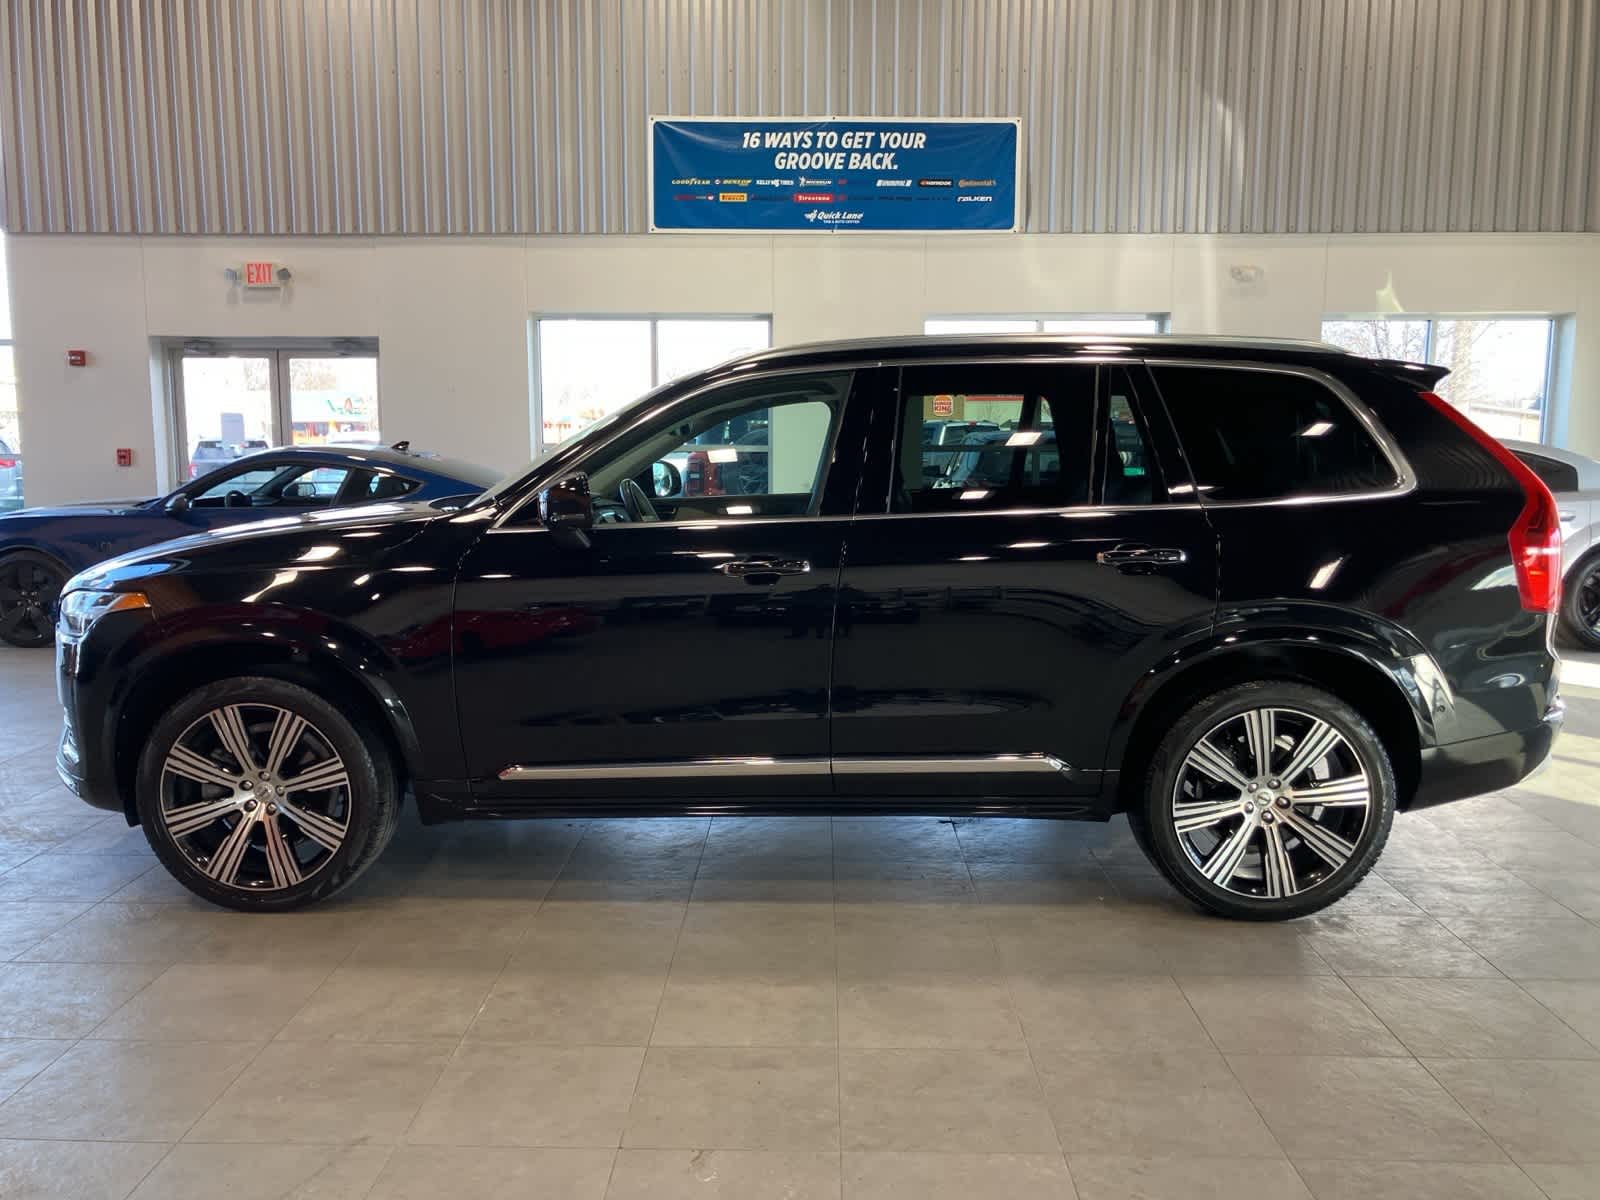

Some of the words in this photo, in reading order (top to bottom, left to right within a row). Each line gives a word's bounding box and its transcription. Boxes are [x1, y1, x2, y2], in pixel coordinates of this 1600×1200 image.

[742, 132, 760, 149] 16
[764, 132, 813, 149] WAYS
[816, 132, 838, 149] TO
[841, 132, 875, 149] GET
[879, 132, 927, 149] YOUR
[774, 152, 847, 170] GROOVE
[848, 152, 899, 170] BACK.
[671, 177, 711, 186] GOODYEAR
[817, 211, 841, 220] Quick
[841, 211, 864, 220] Lane
[246, 263, 273, 284] EXIT
